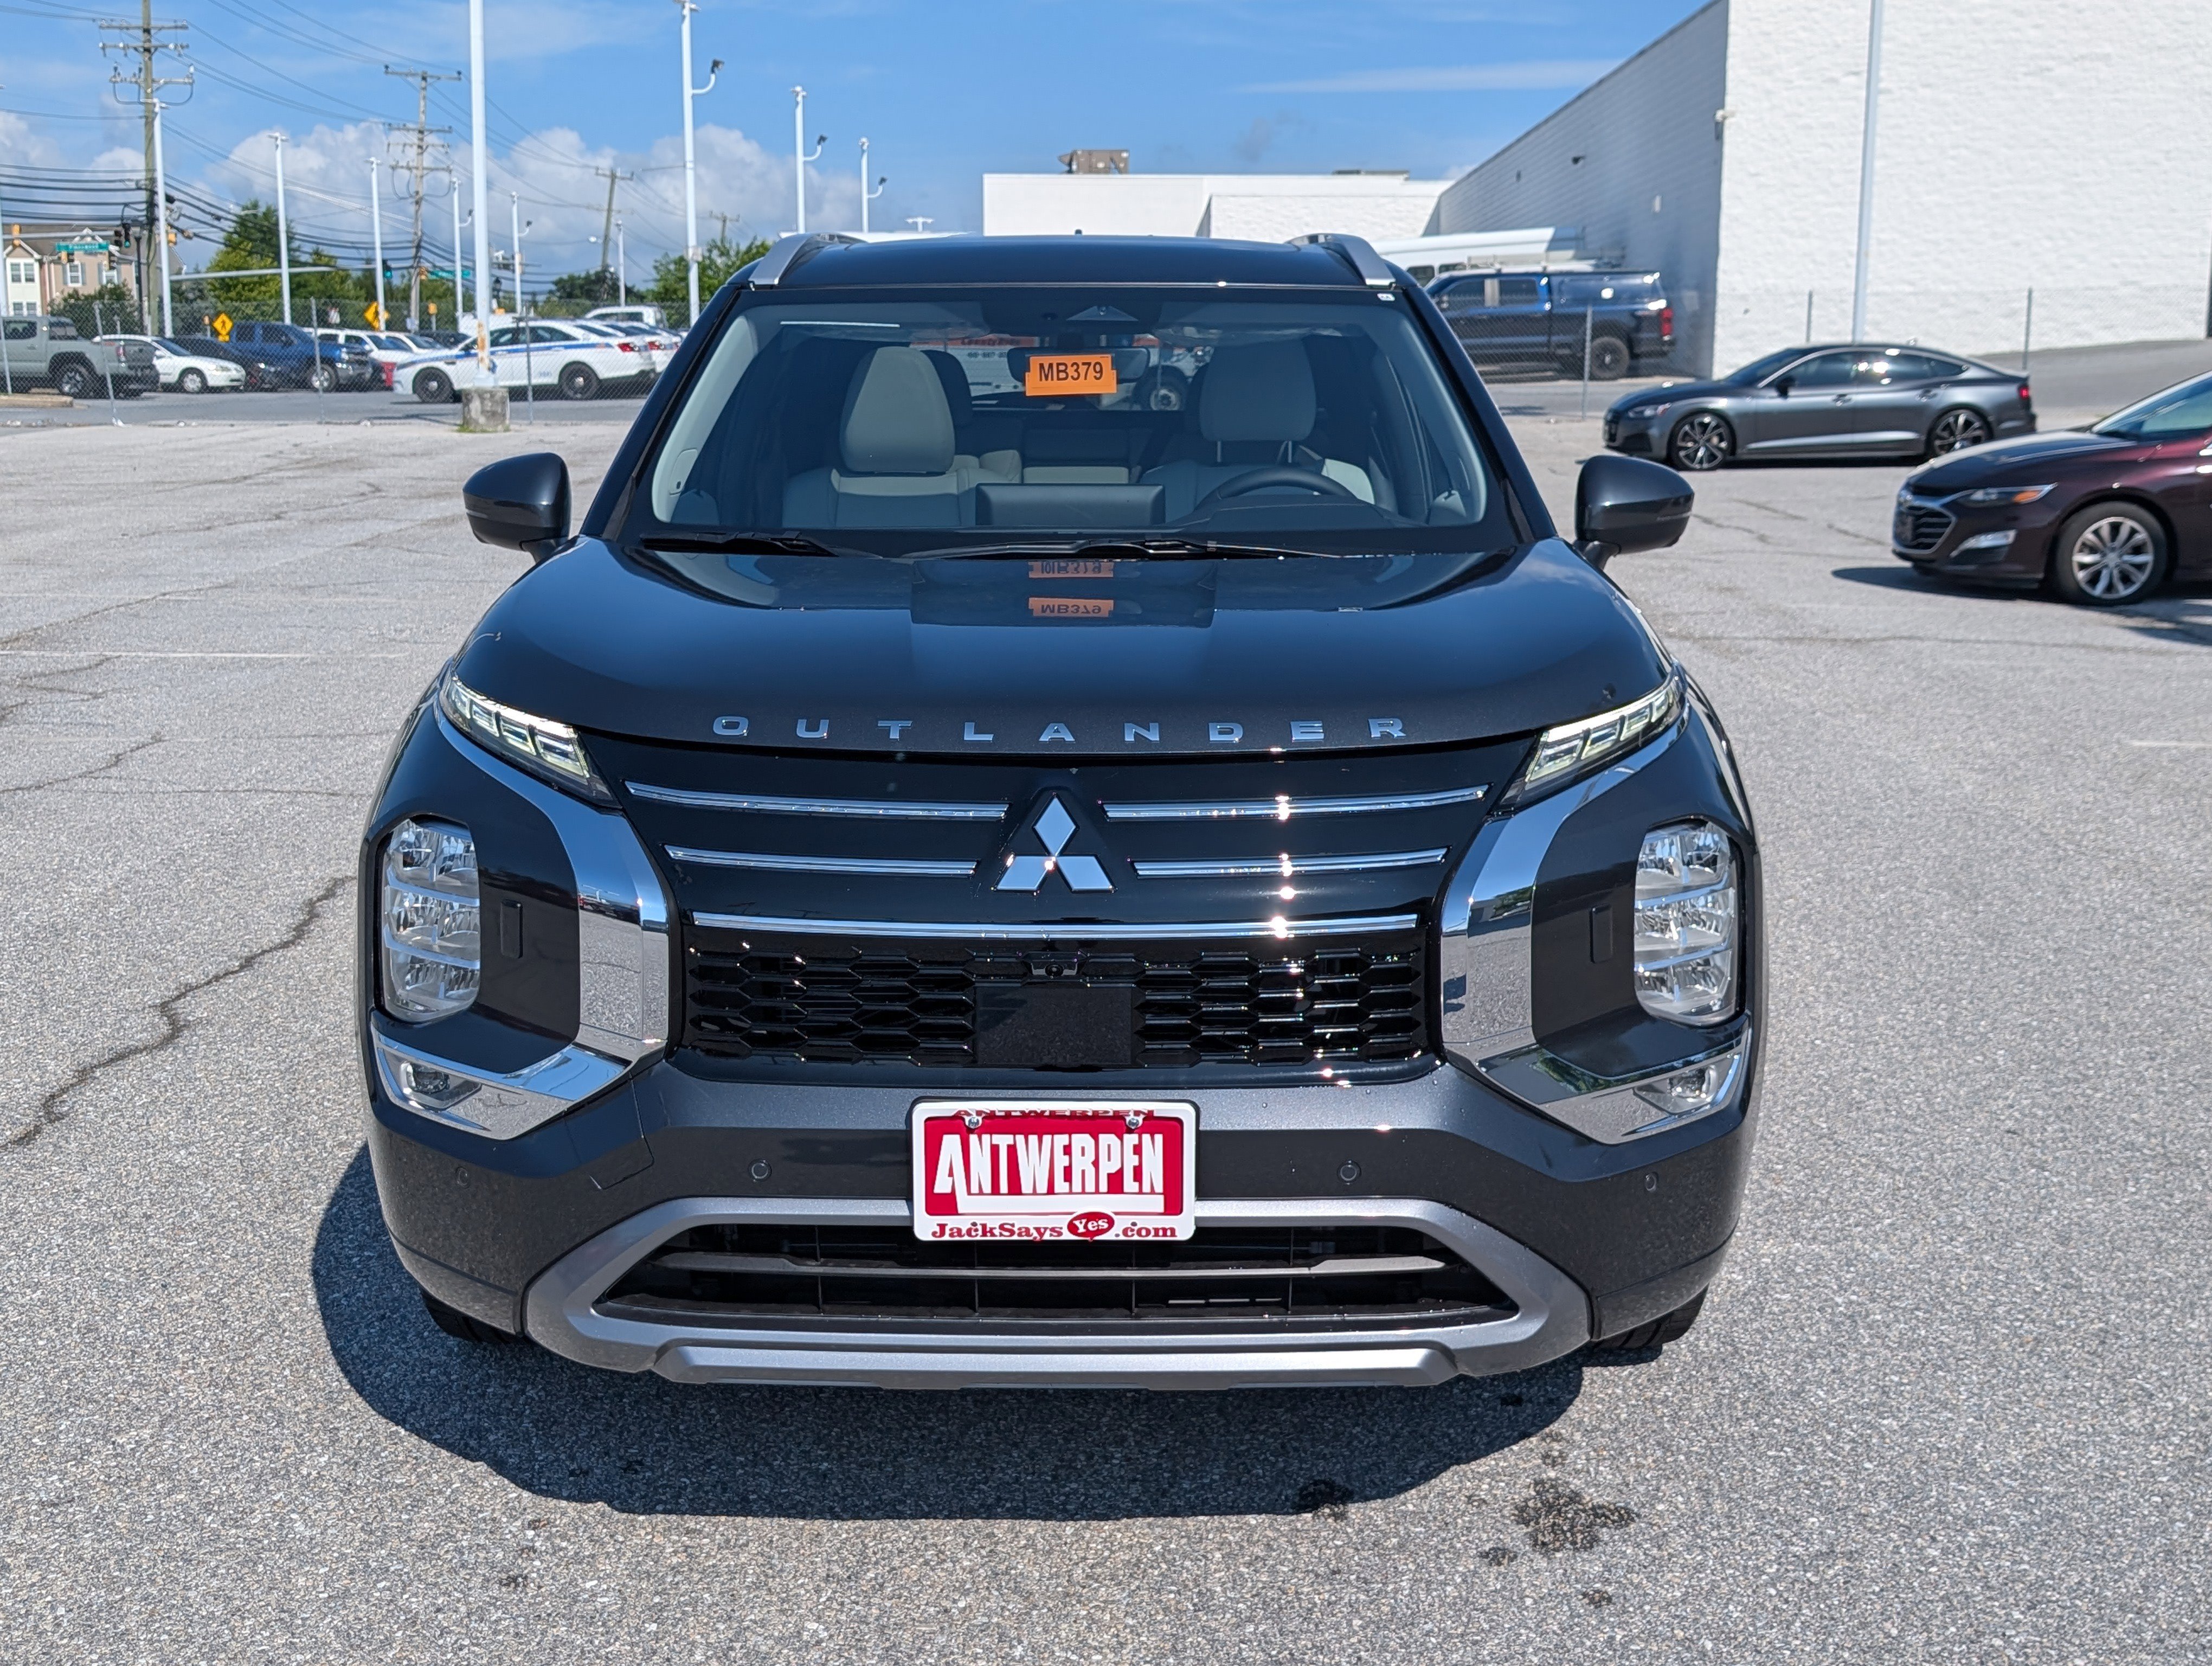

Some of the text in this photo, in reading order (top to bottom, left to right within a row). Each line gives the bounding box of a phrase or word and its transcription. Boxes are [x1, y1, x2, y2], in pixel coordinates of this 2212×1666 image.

[1039, 361, 1103, 382] MB379
[712, 716, 1406, 742] OUTLANDER
[933, 1133, 1164, 1195] ANTWERPEN
[931, 1222, 1063, 1241] JackSays
[1074, 1217, 1109, 1233] Yes
